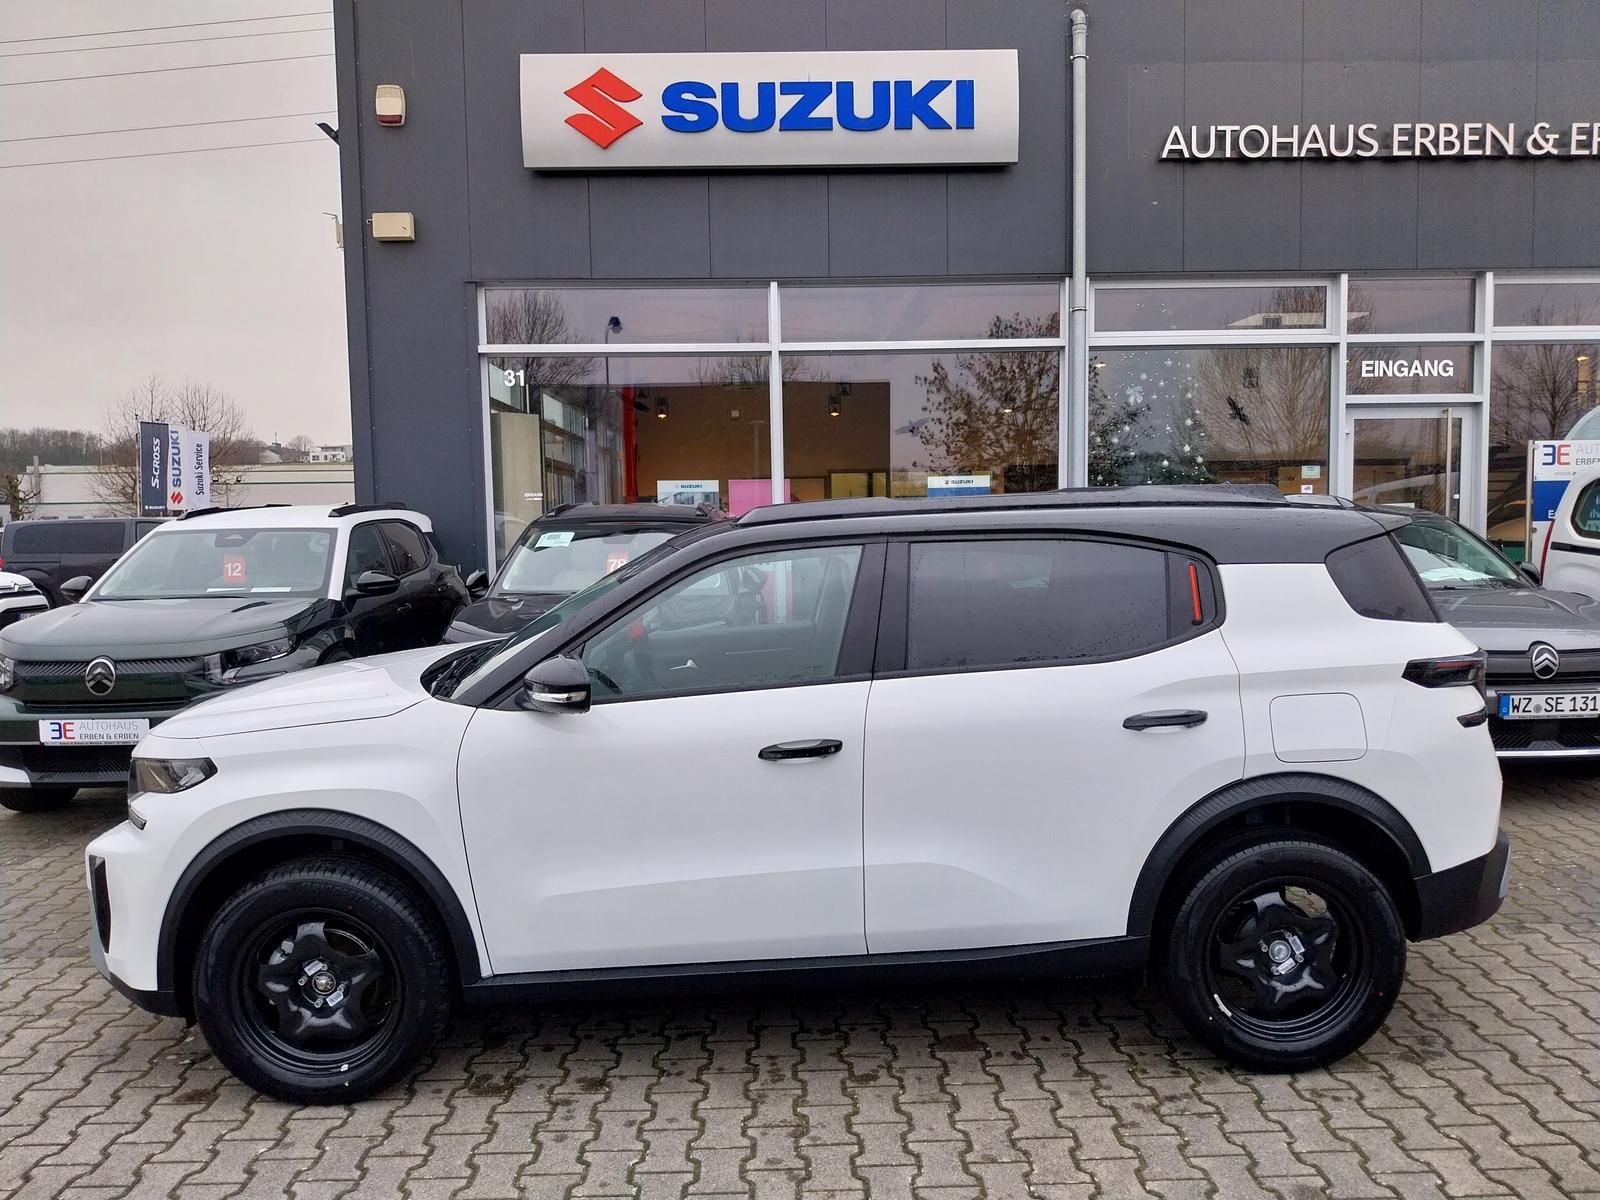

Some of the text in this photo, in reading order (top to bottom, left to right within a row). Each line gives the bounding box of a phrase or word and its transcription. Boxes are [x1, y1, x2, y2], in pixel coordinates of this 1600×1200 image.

[661, 80, 975, 132] SUZUKI
[1161, 123, 1379, 159] AUTOHAUS
[1392, 122, 1515, 157] ERBEN
[1526, 121, 1559, 156] &
[1361, 359, 1454, 377] EINGANG
[504, 369, 525, 387] 31
[170, 430, 182, 488] SUZUKI
[194, 443, 204, 496] Suzuki Service
[225, 562, 242, 577] 12
[1511, 695, 1598, 714] WZ SE 131
[80, 720, 138, 730] AUTOHAUS
